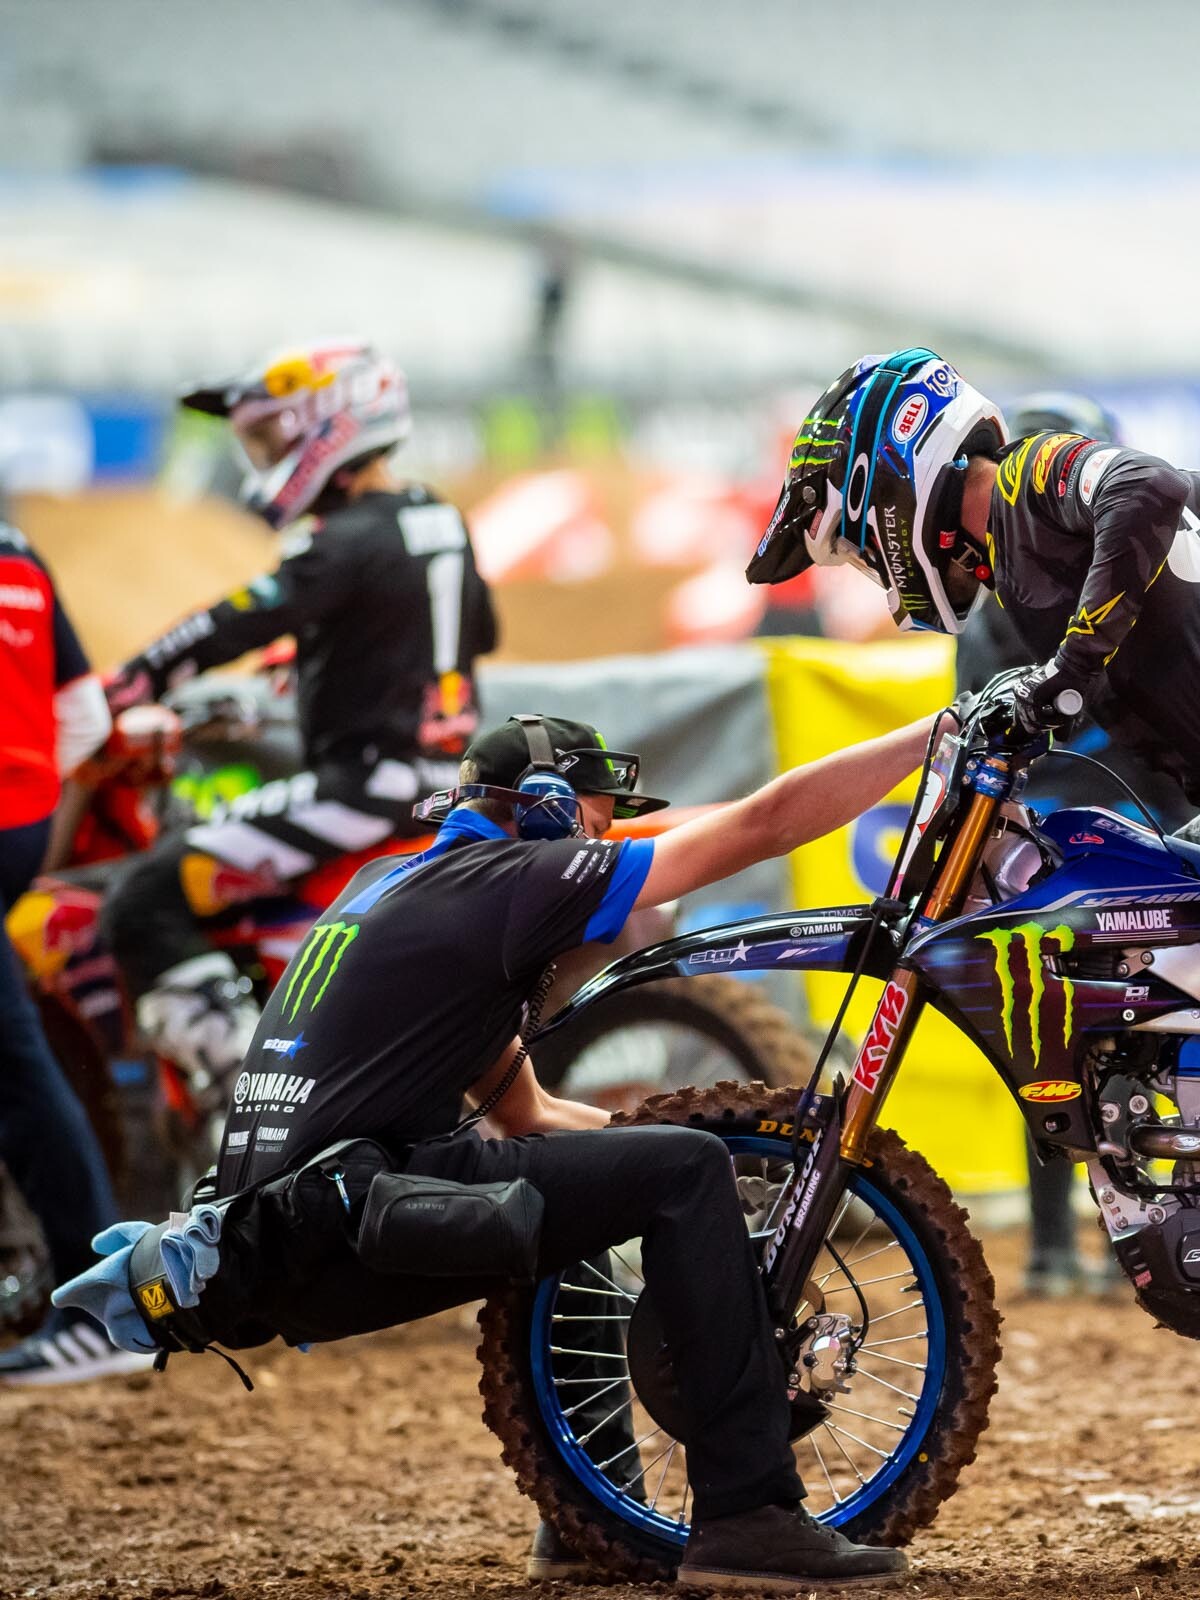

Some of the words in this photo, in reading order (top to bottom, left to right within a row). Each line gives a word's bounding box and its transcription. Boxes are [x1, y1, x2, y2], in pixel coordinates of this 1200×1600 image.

[898, 402, 924, 437] BELL
[884, 505, 907, 588] MONSTER
[900, 519, 915, 577] ENERGY
[821, 908, 863, 918] TOMAC
[1095, 909, 1172, 932] YAMALUBE
[801, 922, 844, 936] YAMAHA
[688, 948, 738, 965] star
[852, 980, 909, 1095] KYB
[248, 1073, 317, 1104] YAMAHA
[1020, 1082, 1083, 1098] FMF
[235, 1103, 296, 1114] RACING
[793, 1169, 822, 1230] BRAKING
